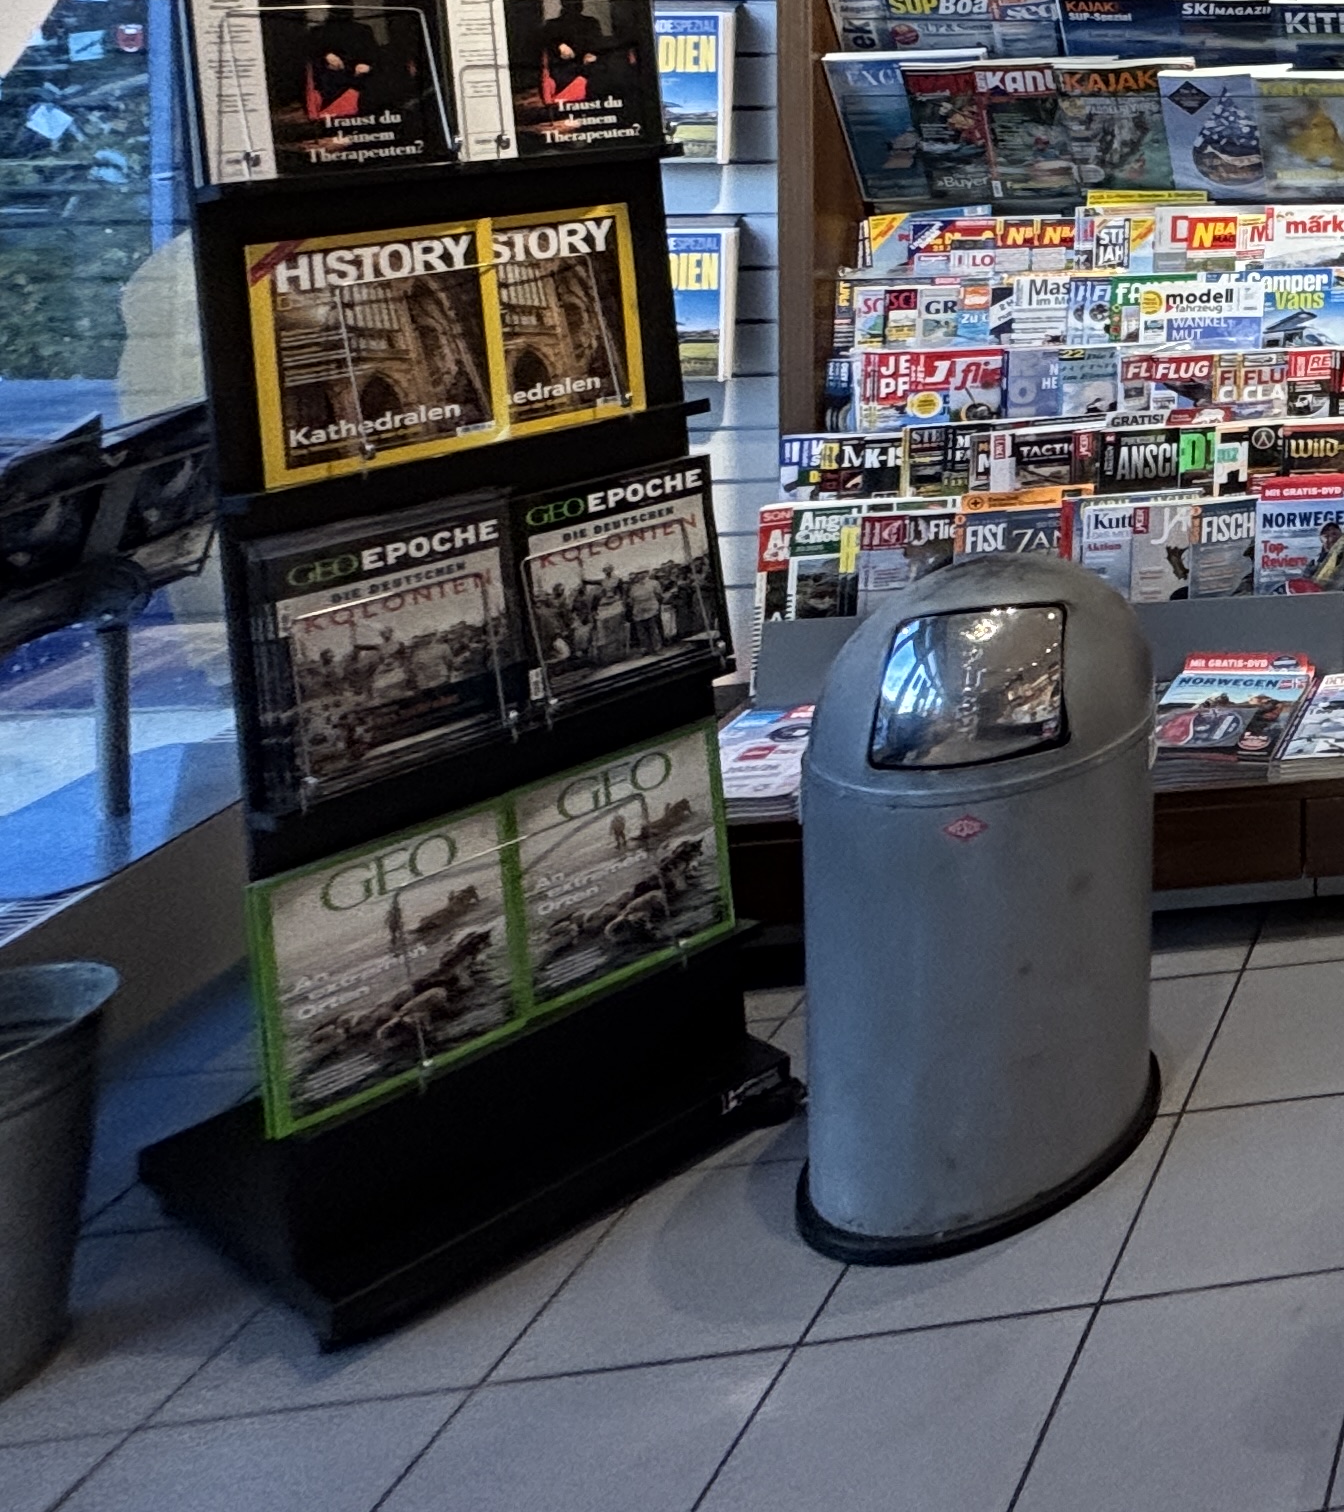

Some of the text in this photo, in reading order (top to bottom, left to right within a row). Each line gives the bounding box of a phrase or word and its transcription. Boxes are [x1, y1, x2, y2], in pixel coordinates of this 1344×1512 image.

[1064, 70, 1157, 92] KAJAK
[556, 98, 602, 113] Traust
[324, 110, 401, 129] Traust du
[331, 128, 395, 144] deinem
[542, 124, 641, 143] Therapeuten?
[309, 140, 425, 163] Therapeuten?
[274, 234, 474, 292] HISTORY
[1165, 288, 1234, 307] modell
[1175, 303, 1223, 315] fahrzeug
[1172, 329, 1203, 341] MUT
[1156, 362, 1210, 379] FLUG
[289, 402, 462, 449] Kathedralen
[1111, 413, 1164, 427] GRATIS!
[526, 469, 702, 528] GEO EPOCHE
[288, 518, 499, 588] GEO EPOCHE
[1210, 656, 1269, 669] GRATIS-DVD
[1177, 675, 1280, 689] NORWEGEN
[556, 752, 672, 822] GEO
[319, 833, 459, 913] GEO
